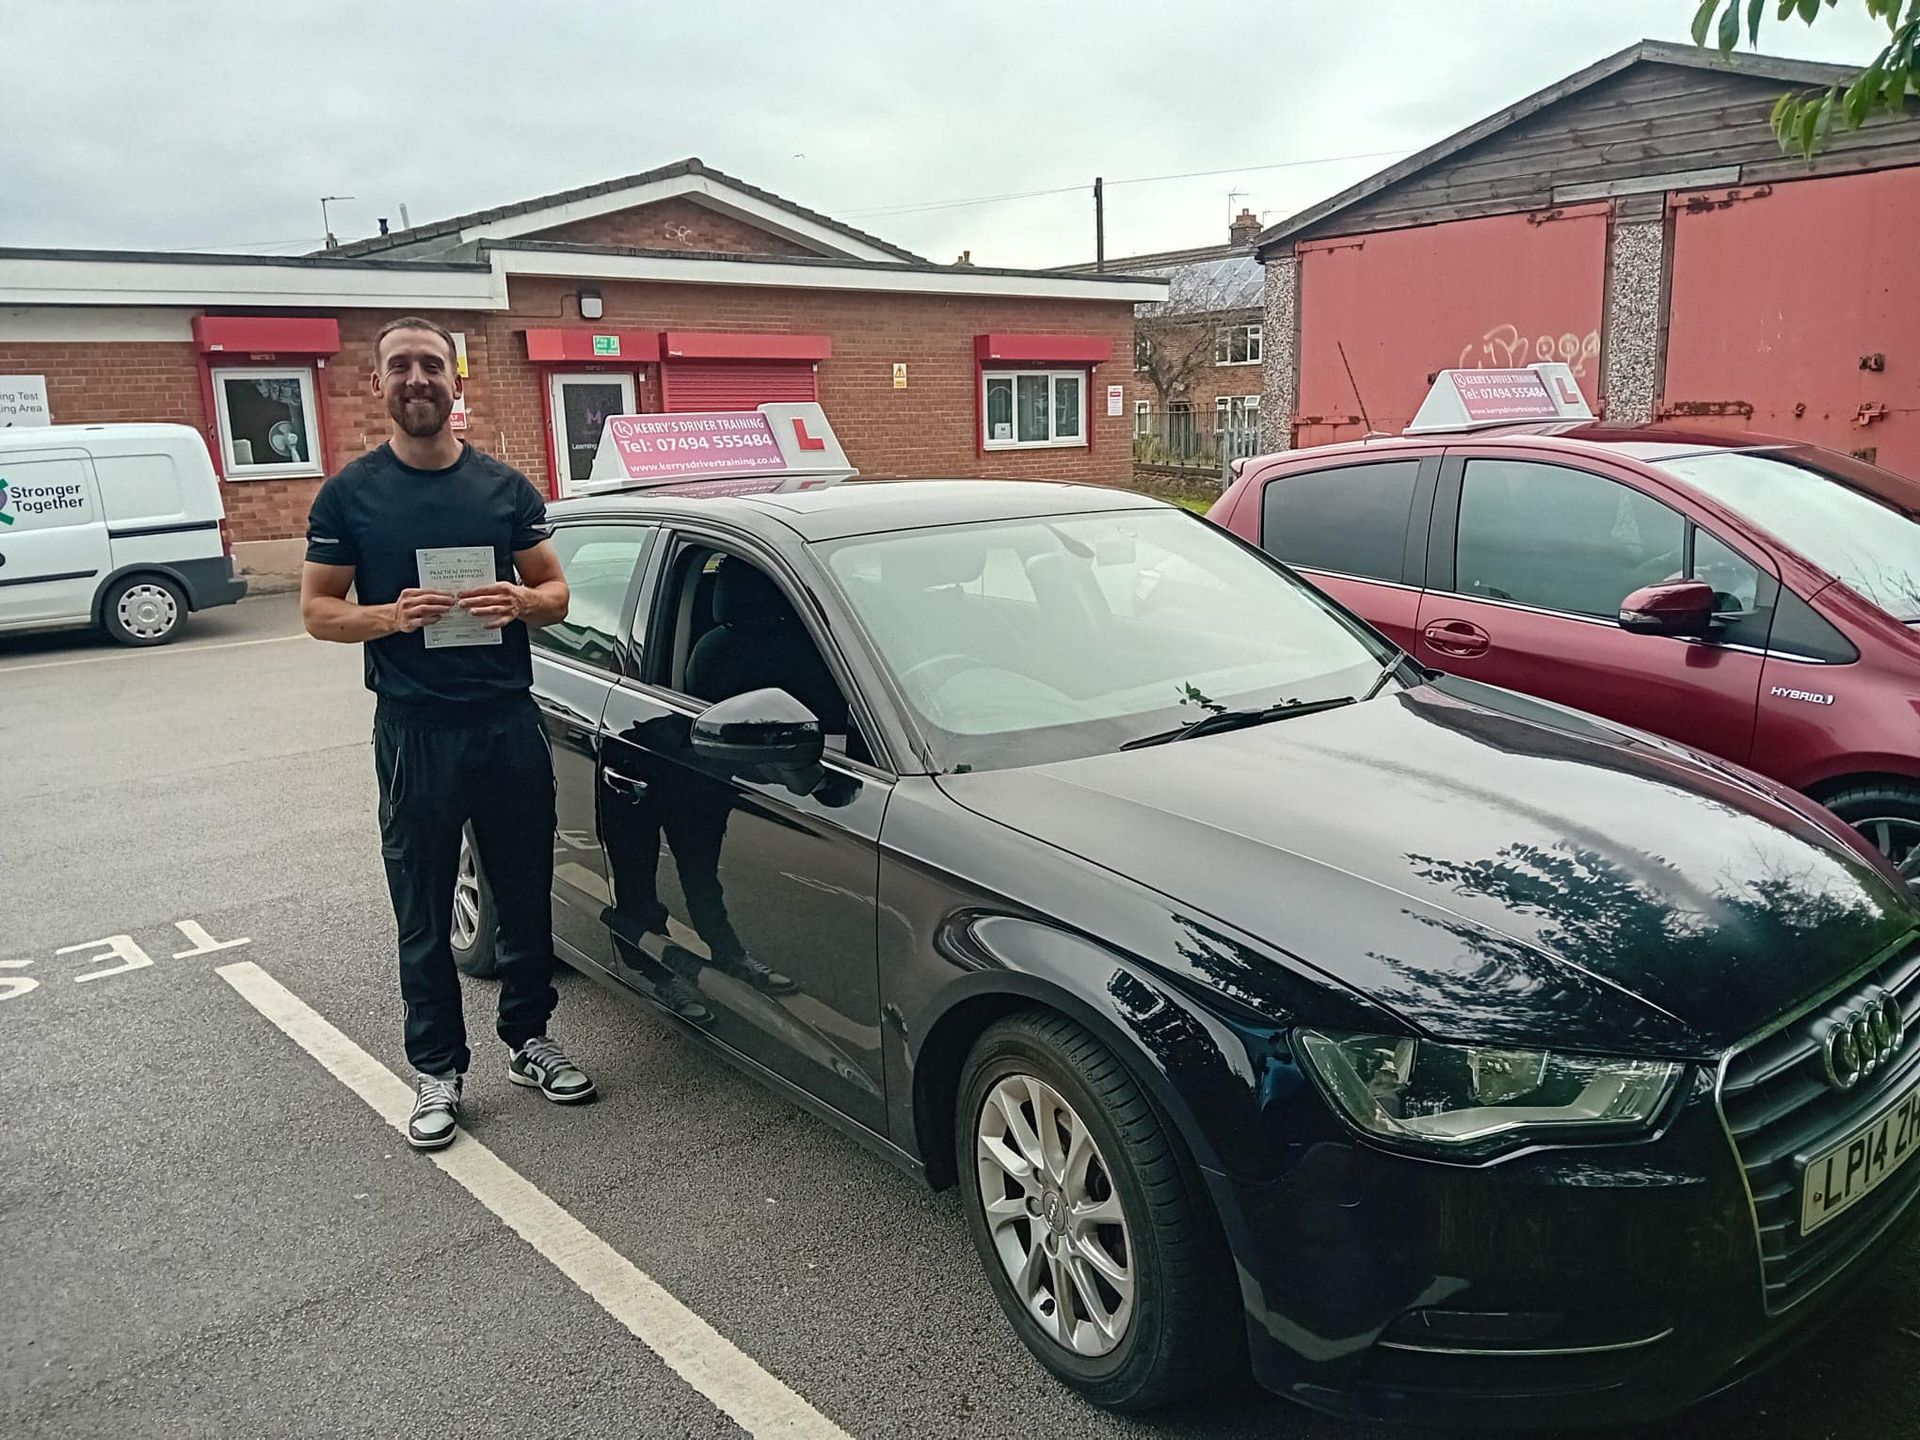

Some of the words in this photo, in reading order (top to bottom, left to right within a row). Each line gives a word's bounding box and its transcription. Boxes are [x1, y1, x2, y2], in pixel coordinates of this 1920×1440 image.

[17, 391, 39, 400] Test
[1460, 389, 1480, 400] Tel:
[1481, 388, 1512, 399] 07494
[1512, 387, 1548, 398] 555484
[0, 404, 17, 414] ing
[19, 404, 43, 413] Area
[633, 419, 680, 435] KERRY'S
[679, 419, 716, 433] DRIVER
[717, 417, 765, 431] TRAINING
[791, 418, 825, 450] L
[620, 439, 653, 454] Tel:
[656, 436, 709, 452] 07494
[713, 433, 773, 449] 555484
[630, 455, 782, 474] www.kerrysdrivertraining.co.uk
[10, 484, 81, 499] Stronger
[12, 496, 85, 514] Together
[1770, 686, 1824, 704] HYBRID
[1823, 1120, 1889, 1212] LP14
